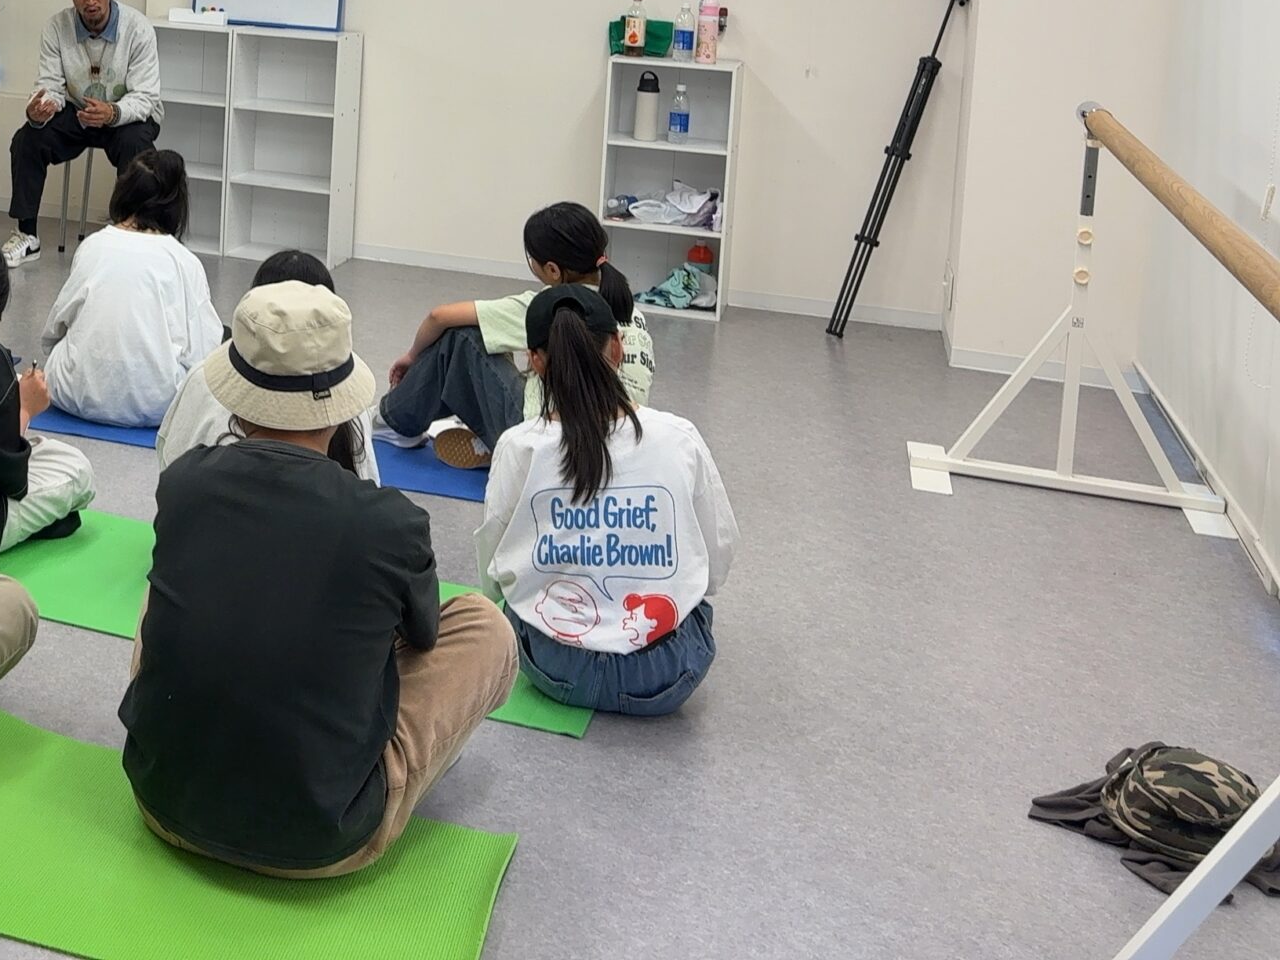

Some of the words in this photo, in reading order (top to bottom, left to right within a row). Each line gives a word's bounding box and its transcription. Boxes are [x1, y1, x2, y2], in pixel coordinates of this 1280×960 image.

[550, 495, 601, 530] Good
[603, 494, 658, 531] Grief,
[537, 534, 604, 567] Charlie
[606, 534, 673, 568] Brown!
